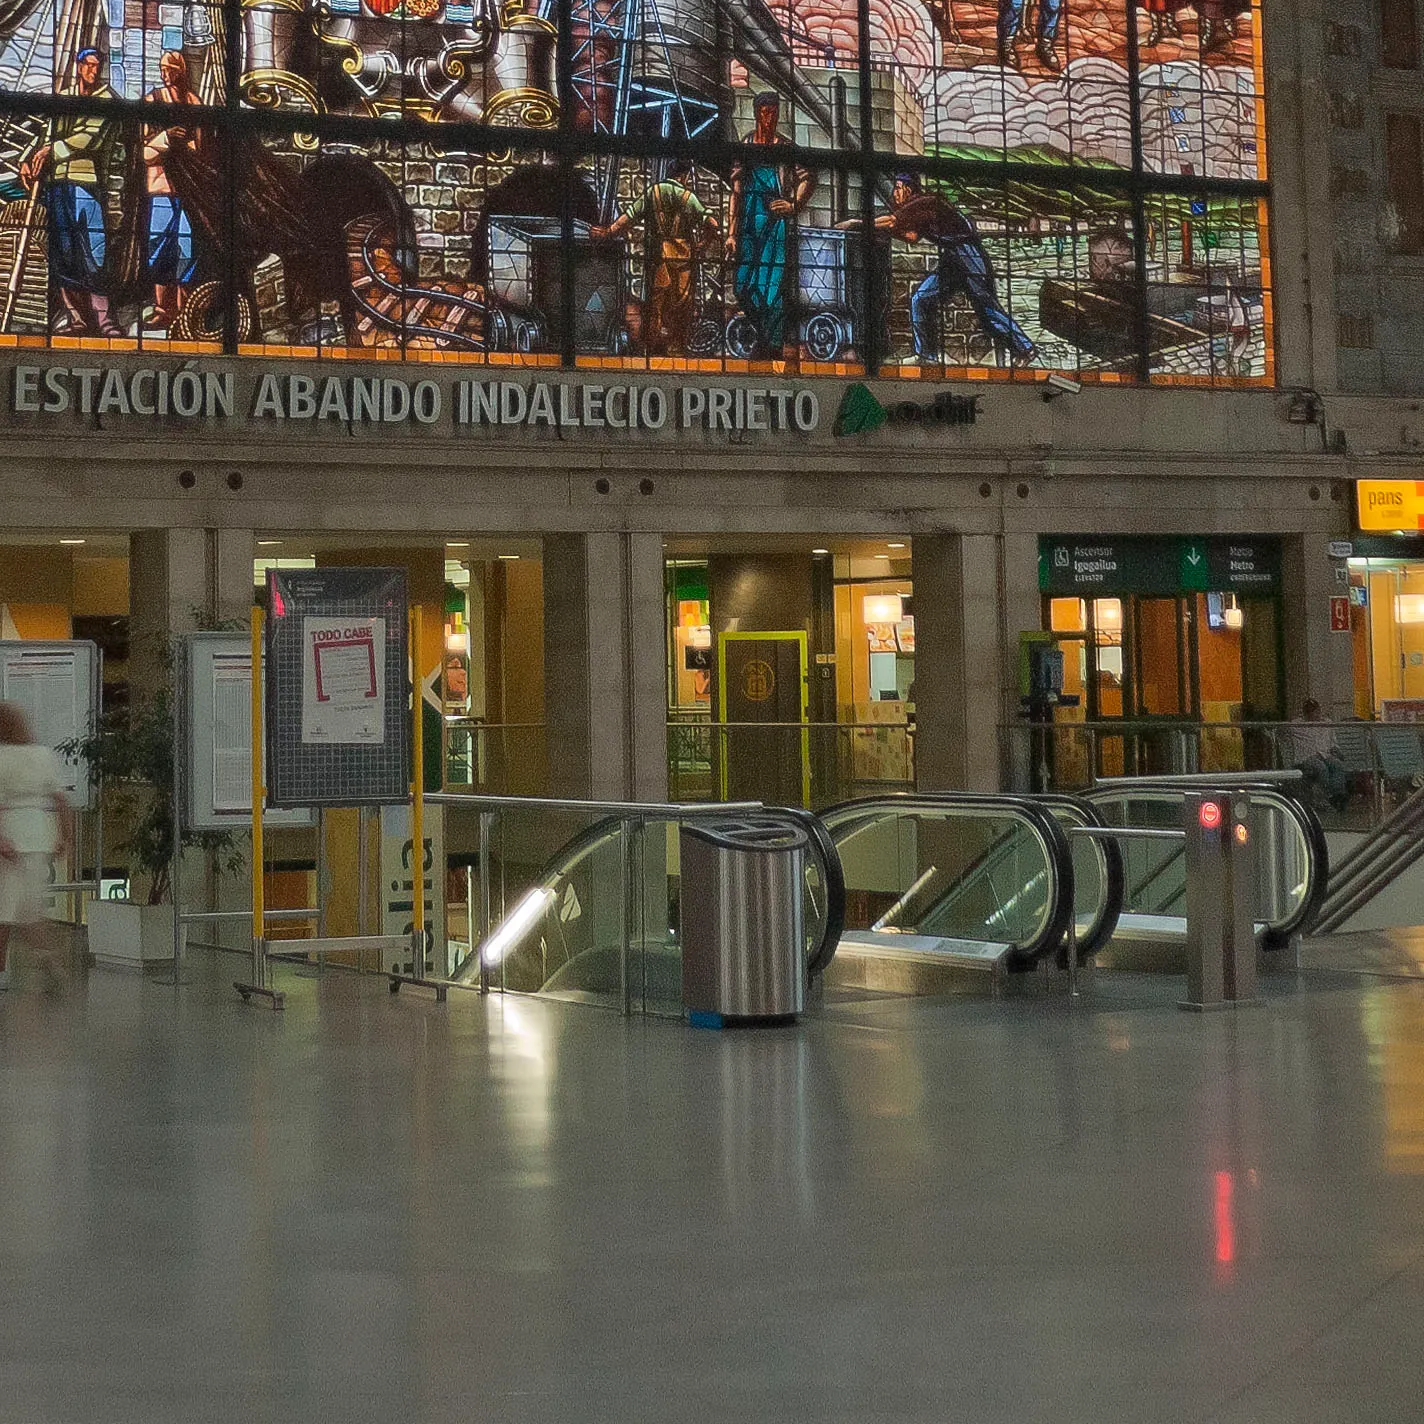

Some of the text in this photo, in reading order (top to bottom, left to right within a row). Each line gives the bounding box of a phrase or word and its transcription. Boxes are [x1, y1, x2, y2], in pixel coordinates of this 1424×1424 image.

[14, 361, 820, 431] ESTACIÓN ABANDO INDALECIO PRIETO
[1368, 491, 1403, 511] pans
[310, 626, 373, 642] TODO CABE
